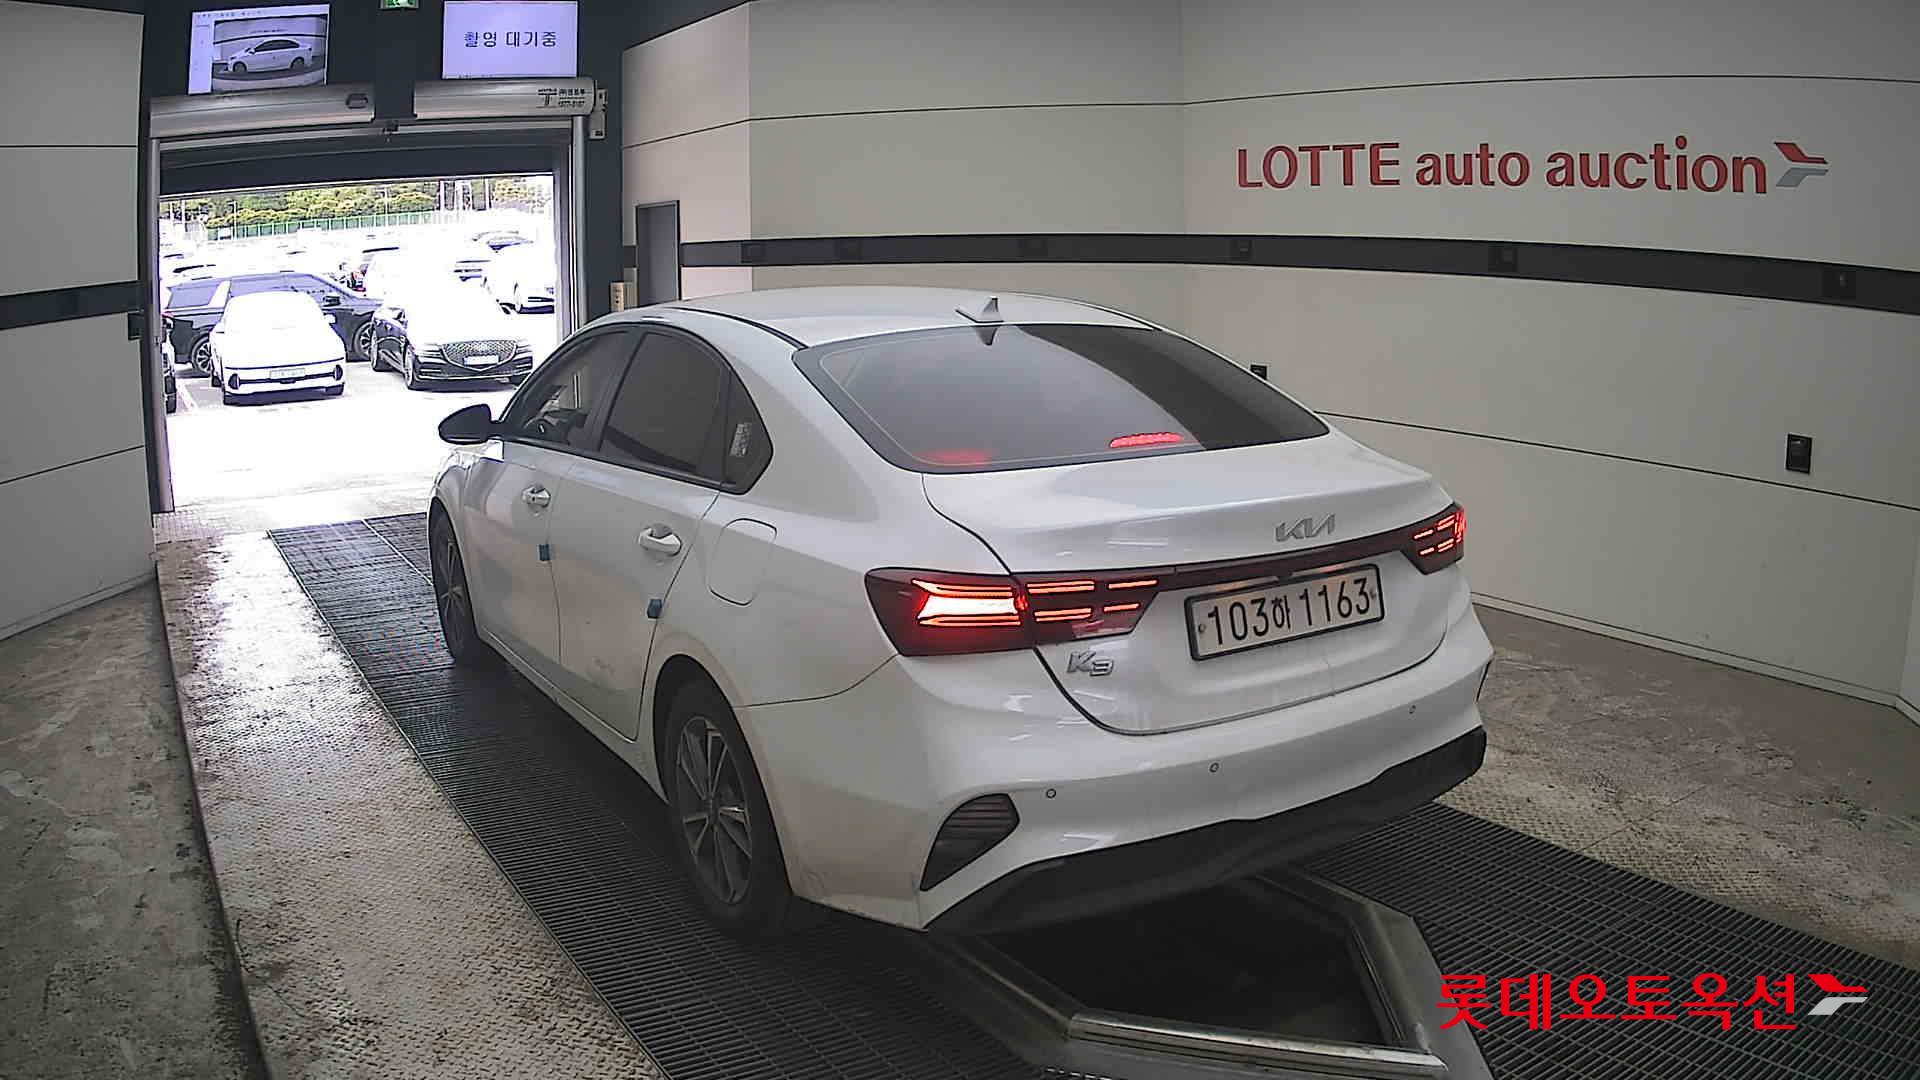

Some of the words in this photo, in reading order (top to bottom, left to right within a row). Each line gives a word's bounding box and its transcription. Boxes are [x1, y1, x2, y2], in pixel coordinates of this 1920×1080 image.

[506, 31, 557, 48] 대기중
[1237, 143, 1399, 188] LOTTE
[1416, 142, 1531, 186] auto
[1546, 135, 1767, 194] auction
[1066, 651, 1115, 677] K3
